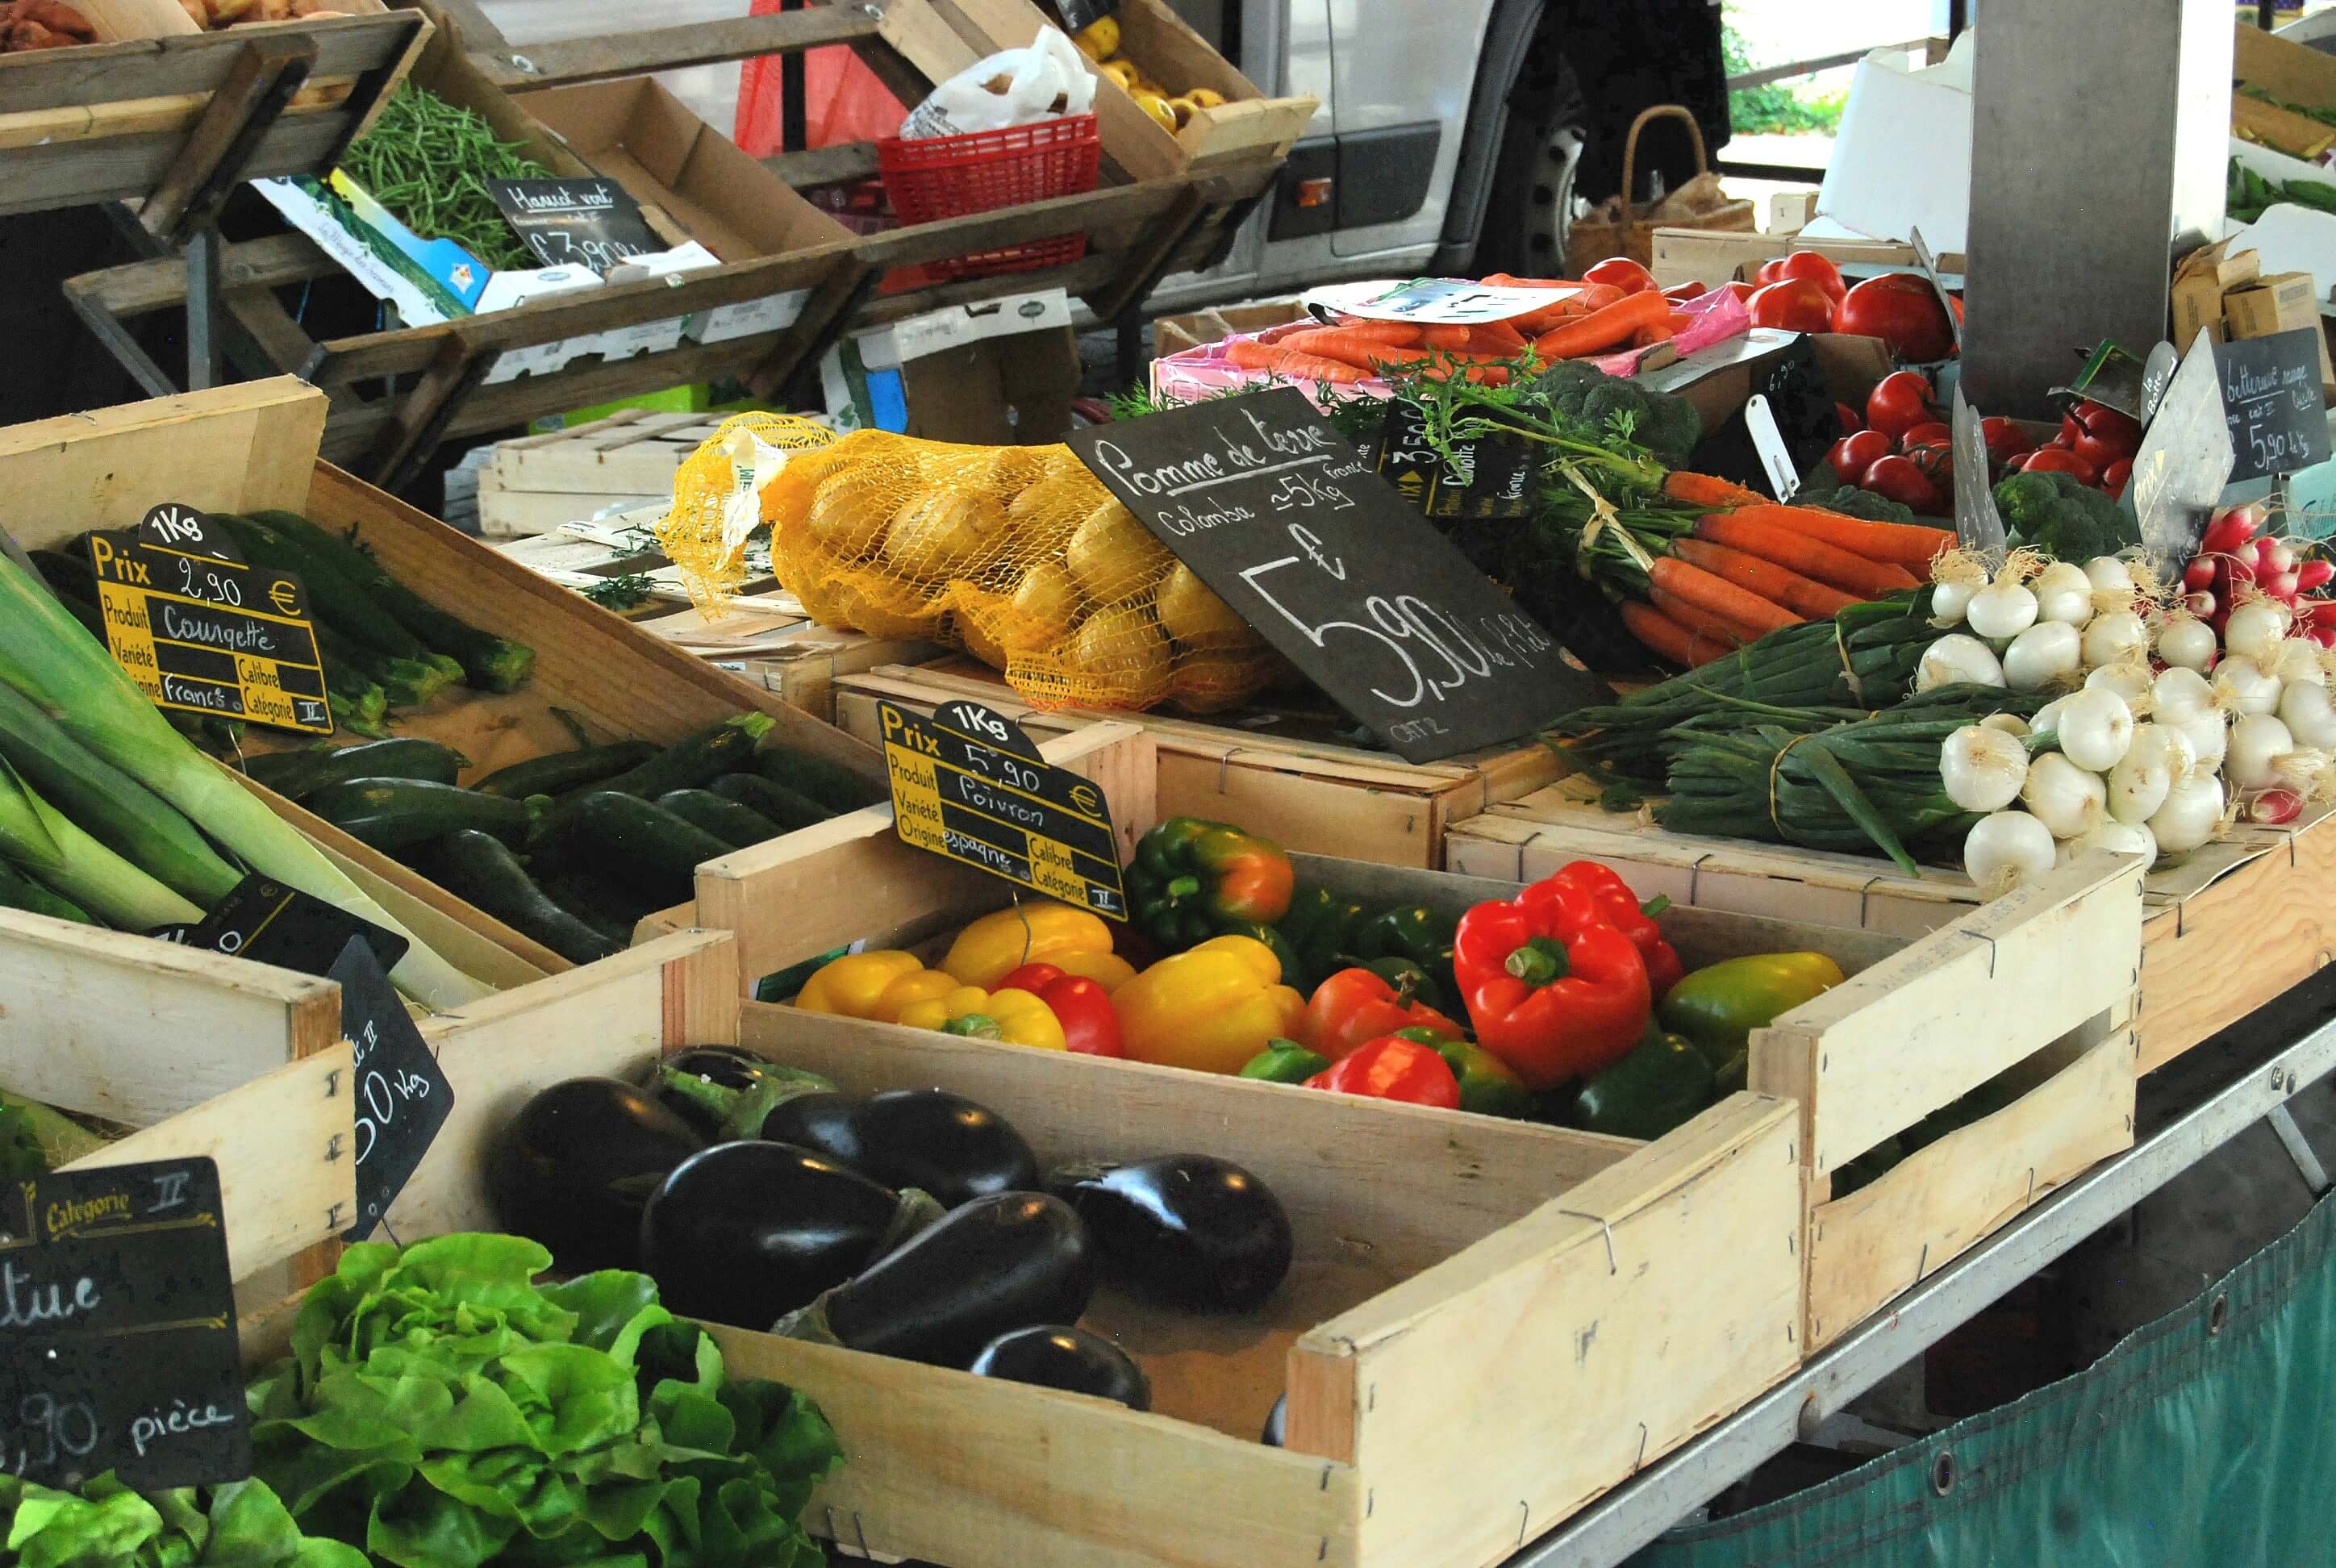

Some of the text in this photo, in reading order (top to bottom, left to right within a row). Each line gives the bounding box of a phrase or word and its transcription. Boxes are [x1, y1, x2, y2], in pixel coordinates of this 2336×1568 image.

[1095, 407, 1337, 497] Pomme de terre
[1323, 461, 1373, 480] France
[2250, 423, 2284, 471] 5,90
[151, 507, 203, 543] 1Kg
[1287, 523, 1345, 580] €
[91, 536, 301, 615] Prix 2,90 €
[103, 594, 275, 650] Produit Courgette
[1238, 556, 1491, 707] 5,90
[111, 636, 279, 687] Variété Calibre
[244, 686, 293, 722] Catégorie
[298, 702, 325, 722] II
[952, 705, 1008, 741] 1Kg
[881, 705, 1102, 817] Prix 5,90 €
[889, 754, 1043, 827] Produit Poivron
[895, 788, 1072, 870] Variété Calibre
[900, 815, 945, 849] Origine
[1032, 861, 1085, 901] Catégorie
[148, 1172, 190, 1212] II
[131, 1399, 235, 1457] pièce
